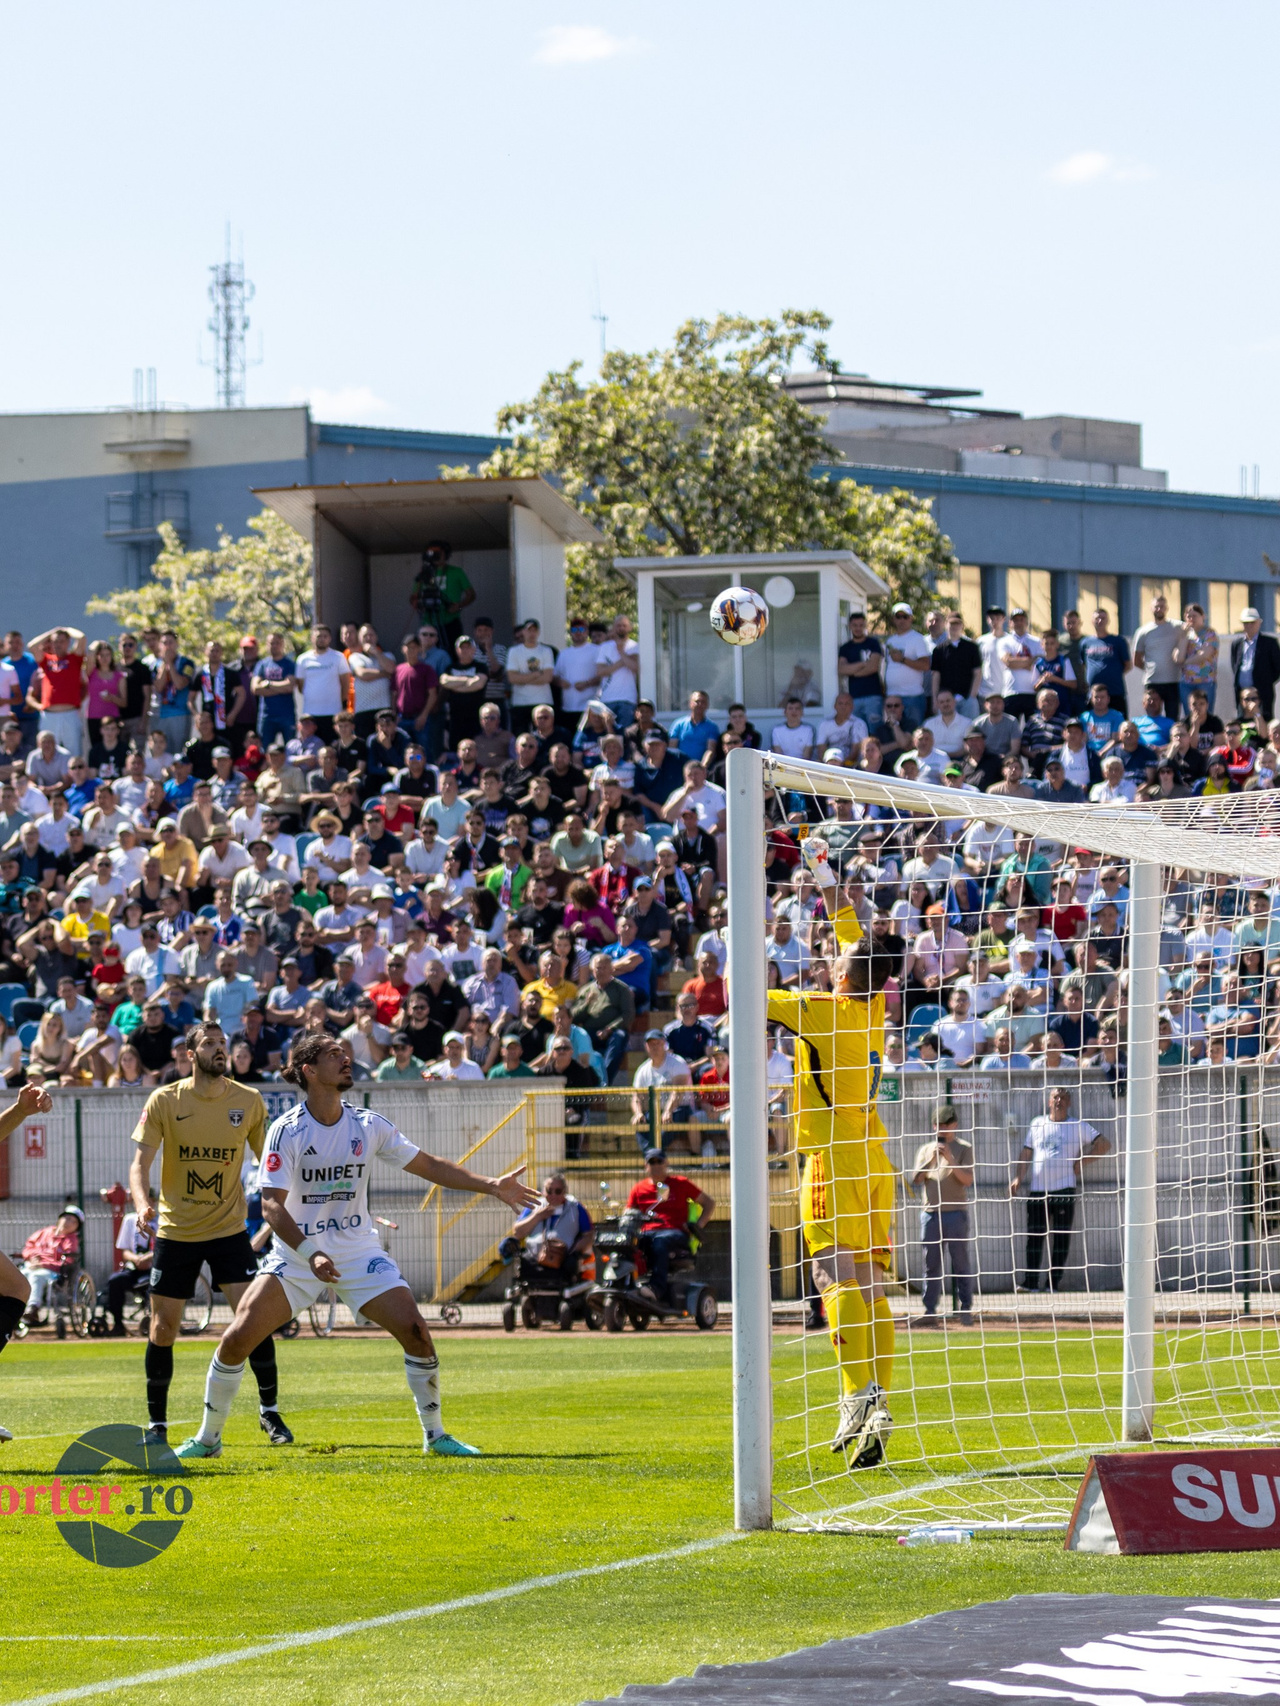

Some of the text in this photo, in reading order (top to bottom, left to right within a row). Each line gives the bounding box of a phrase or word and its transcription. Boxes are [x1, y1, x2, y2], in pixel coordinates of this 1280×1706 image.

[179, 1145, 237, 1161] MAXBET
[302, 1164, 365, 1182] UNIBET
[296, 1214, 362, 1236] LSACO
[1171, 1464, 1280, 1529] SU
